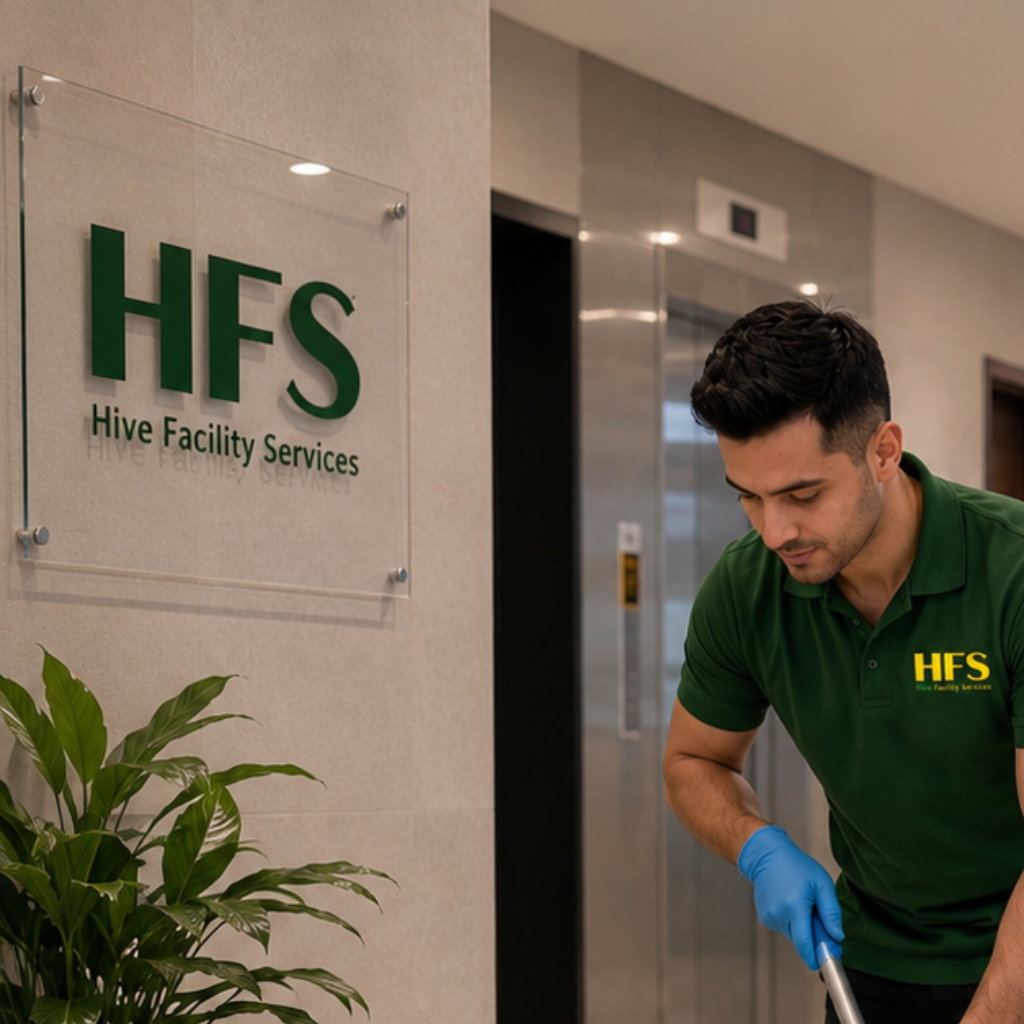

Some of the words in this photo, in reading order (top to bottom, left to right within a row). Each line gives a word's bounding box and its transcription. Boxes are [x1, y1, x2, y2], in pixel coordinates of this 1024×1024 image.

[90, 222, 361, 420] HFS
[92, 403, 153, 443] Hive
[163, 416, 255, 468] Facility
[264, 433, 359, 476] Services
[913, 651, 991, 682] HFS
